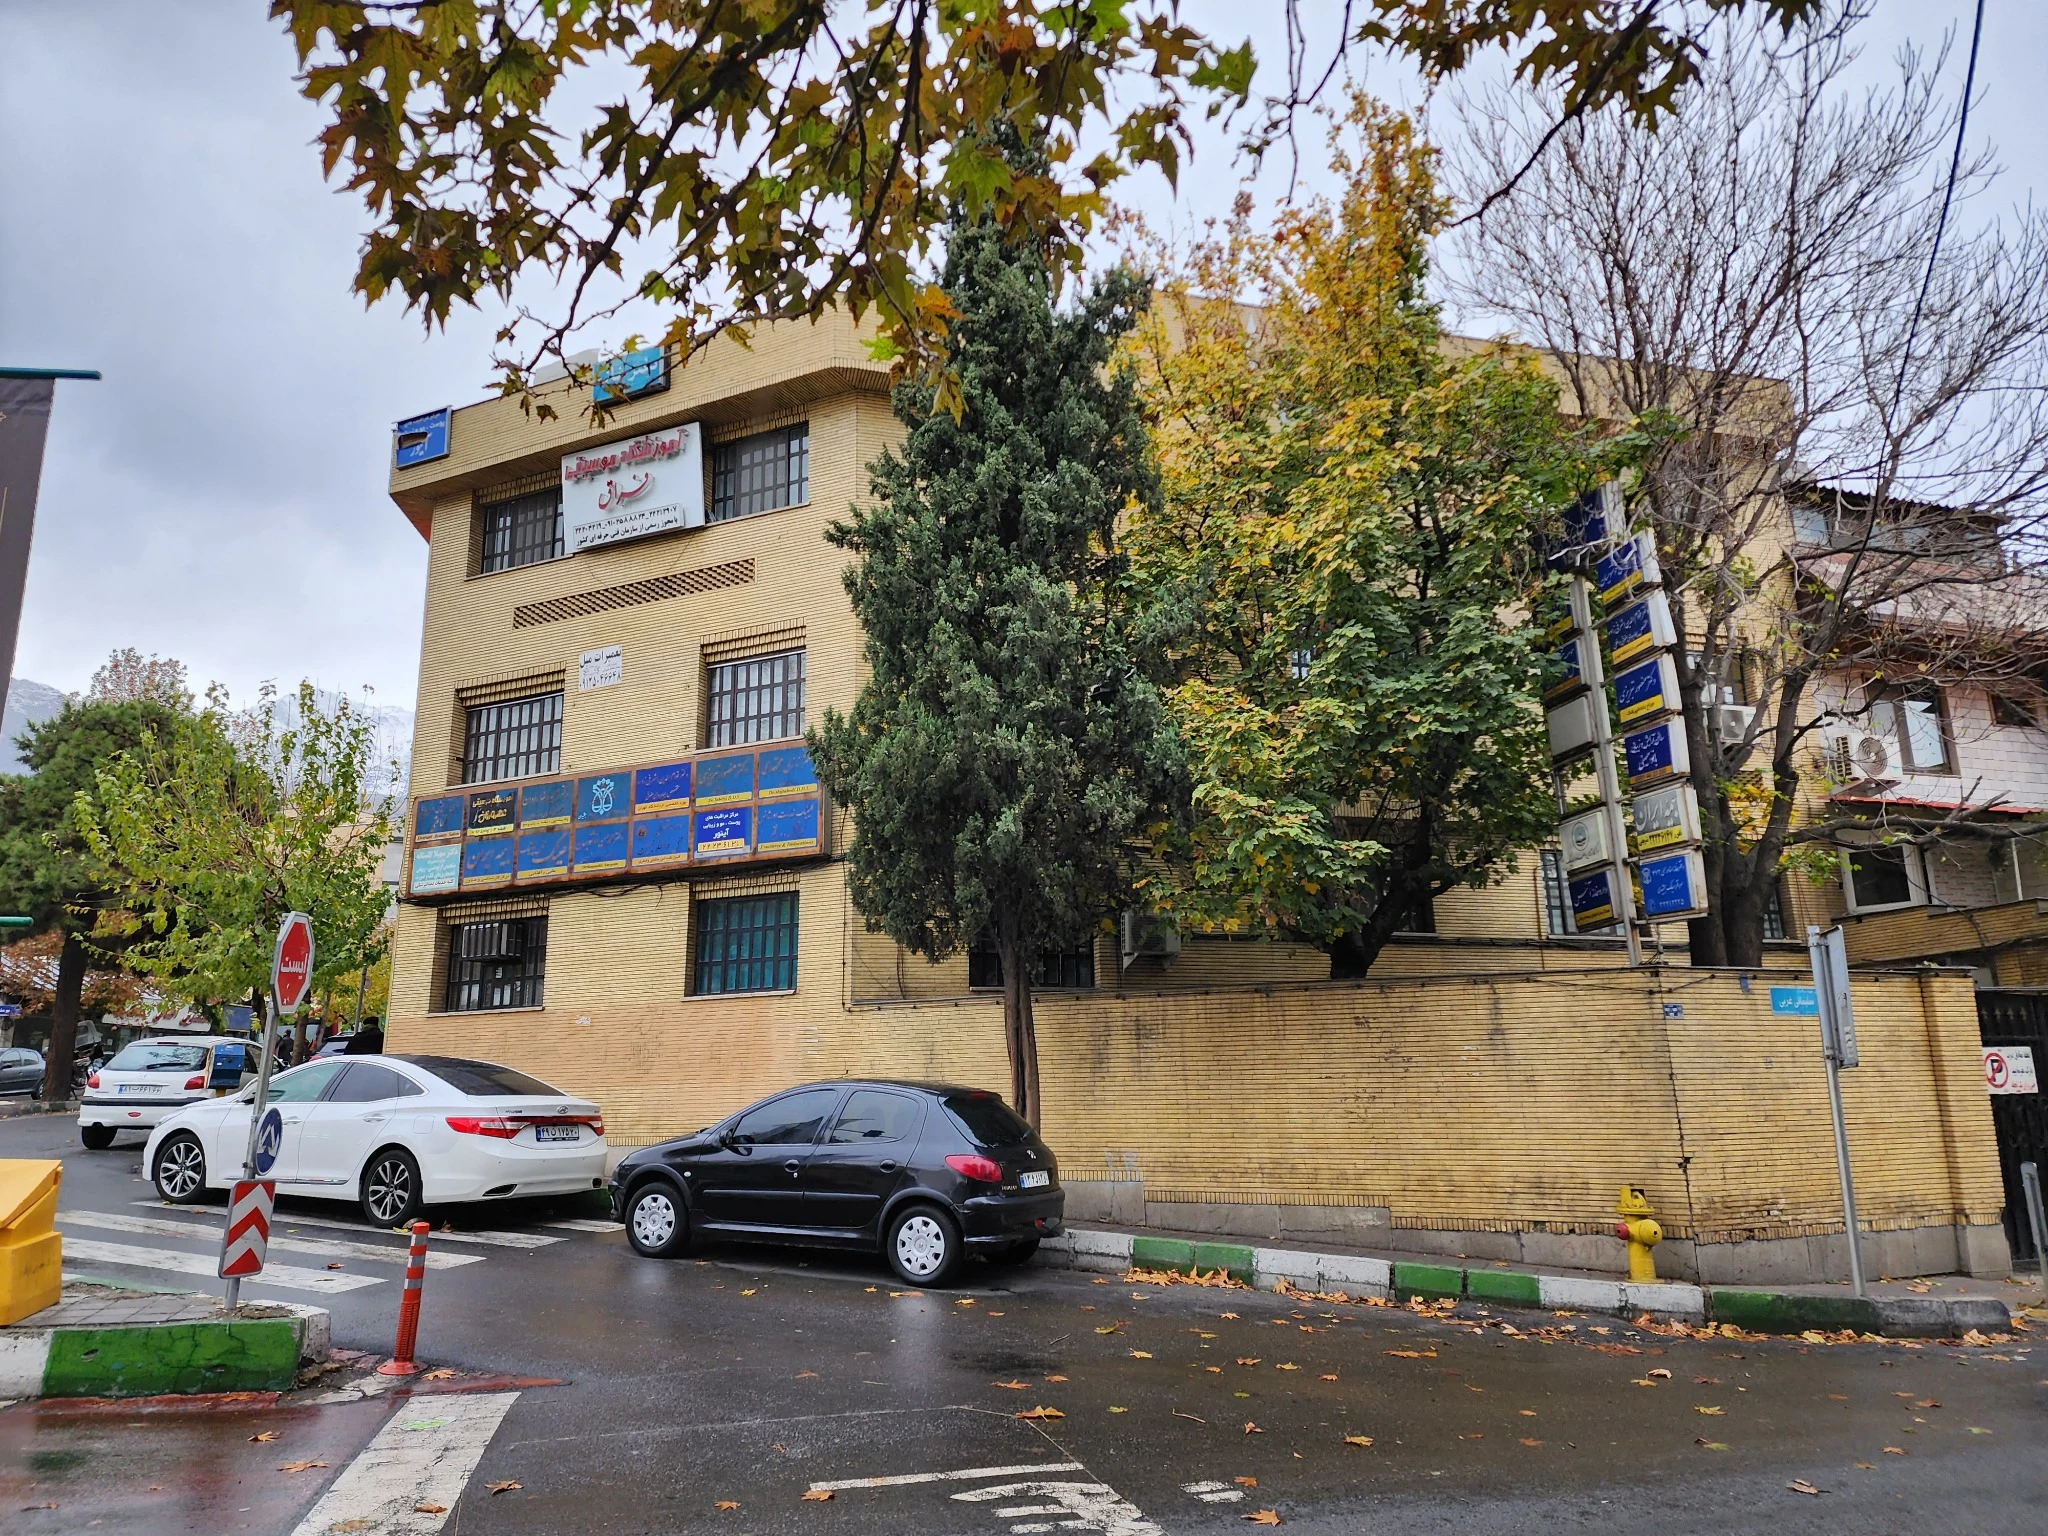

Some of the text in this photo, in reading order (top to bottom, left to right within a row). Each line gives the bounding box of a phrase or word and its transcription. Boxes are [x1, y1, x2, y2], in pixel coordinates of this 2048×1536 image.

[564, 429, 685, 481] آموزشگاه موسیقی
[620, 524, 638, 537] سازمان
[644, 521, 660, 531] رسمی
[610, 527, 620, 539] فنی
[576, 534, 588, 547] کشور
[1635, 799, 1663, 832] ایران
[280, 952, 309, 980] ایست
